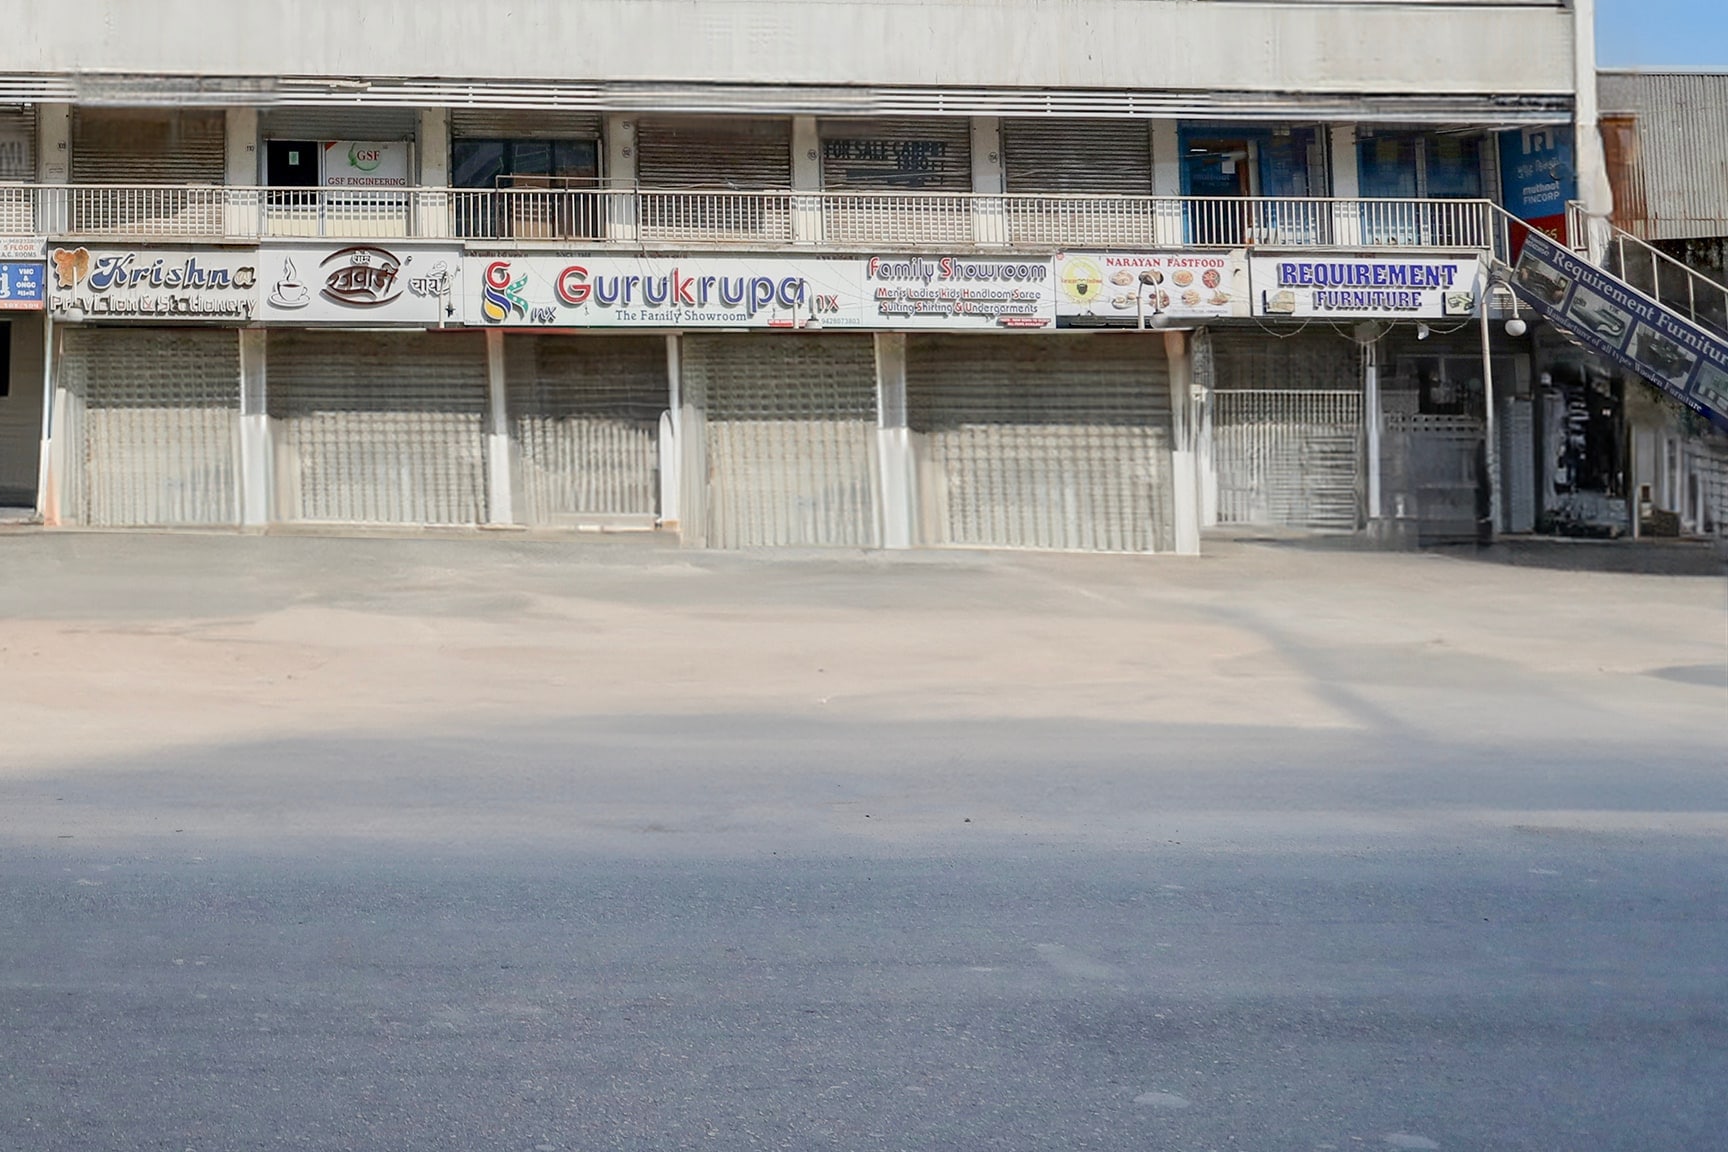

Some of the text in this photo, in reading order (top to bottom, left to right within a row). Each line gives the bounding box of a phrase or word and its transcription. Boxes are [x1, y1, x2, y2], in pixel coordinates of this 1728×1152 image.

[357, 150, 380, 161] GSF
[328, 177, 406, 186] GSF ENGINEERING
[1523, 191, 1560, 205] FINCORP
[940, 258, 1047, 278] Showroom
[1106, 258, 1225, 268] NARAYAN FASTFOOD
[90, 252, 256, 290] Krishna
[1281, 263, 1458, 286] REQUIREMENT
[16, 281, 36, 289] ONGC
[558, 266, 804, 313] Gurukrupa
[909, 288, 1041, 299] Ladies Handloom Saree
[1316, 291, 1422, 307] FURNITURE
[883, 302, 1038, 315] Suiting Shirting & Undergarments
[1552, 249, 1728, 370] Requirement Furnitur
[616, 309, 746, 324] The Family Showroom
[1664, 381, 1702, 412] Furniture
